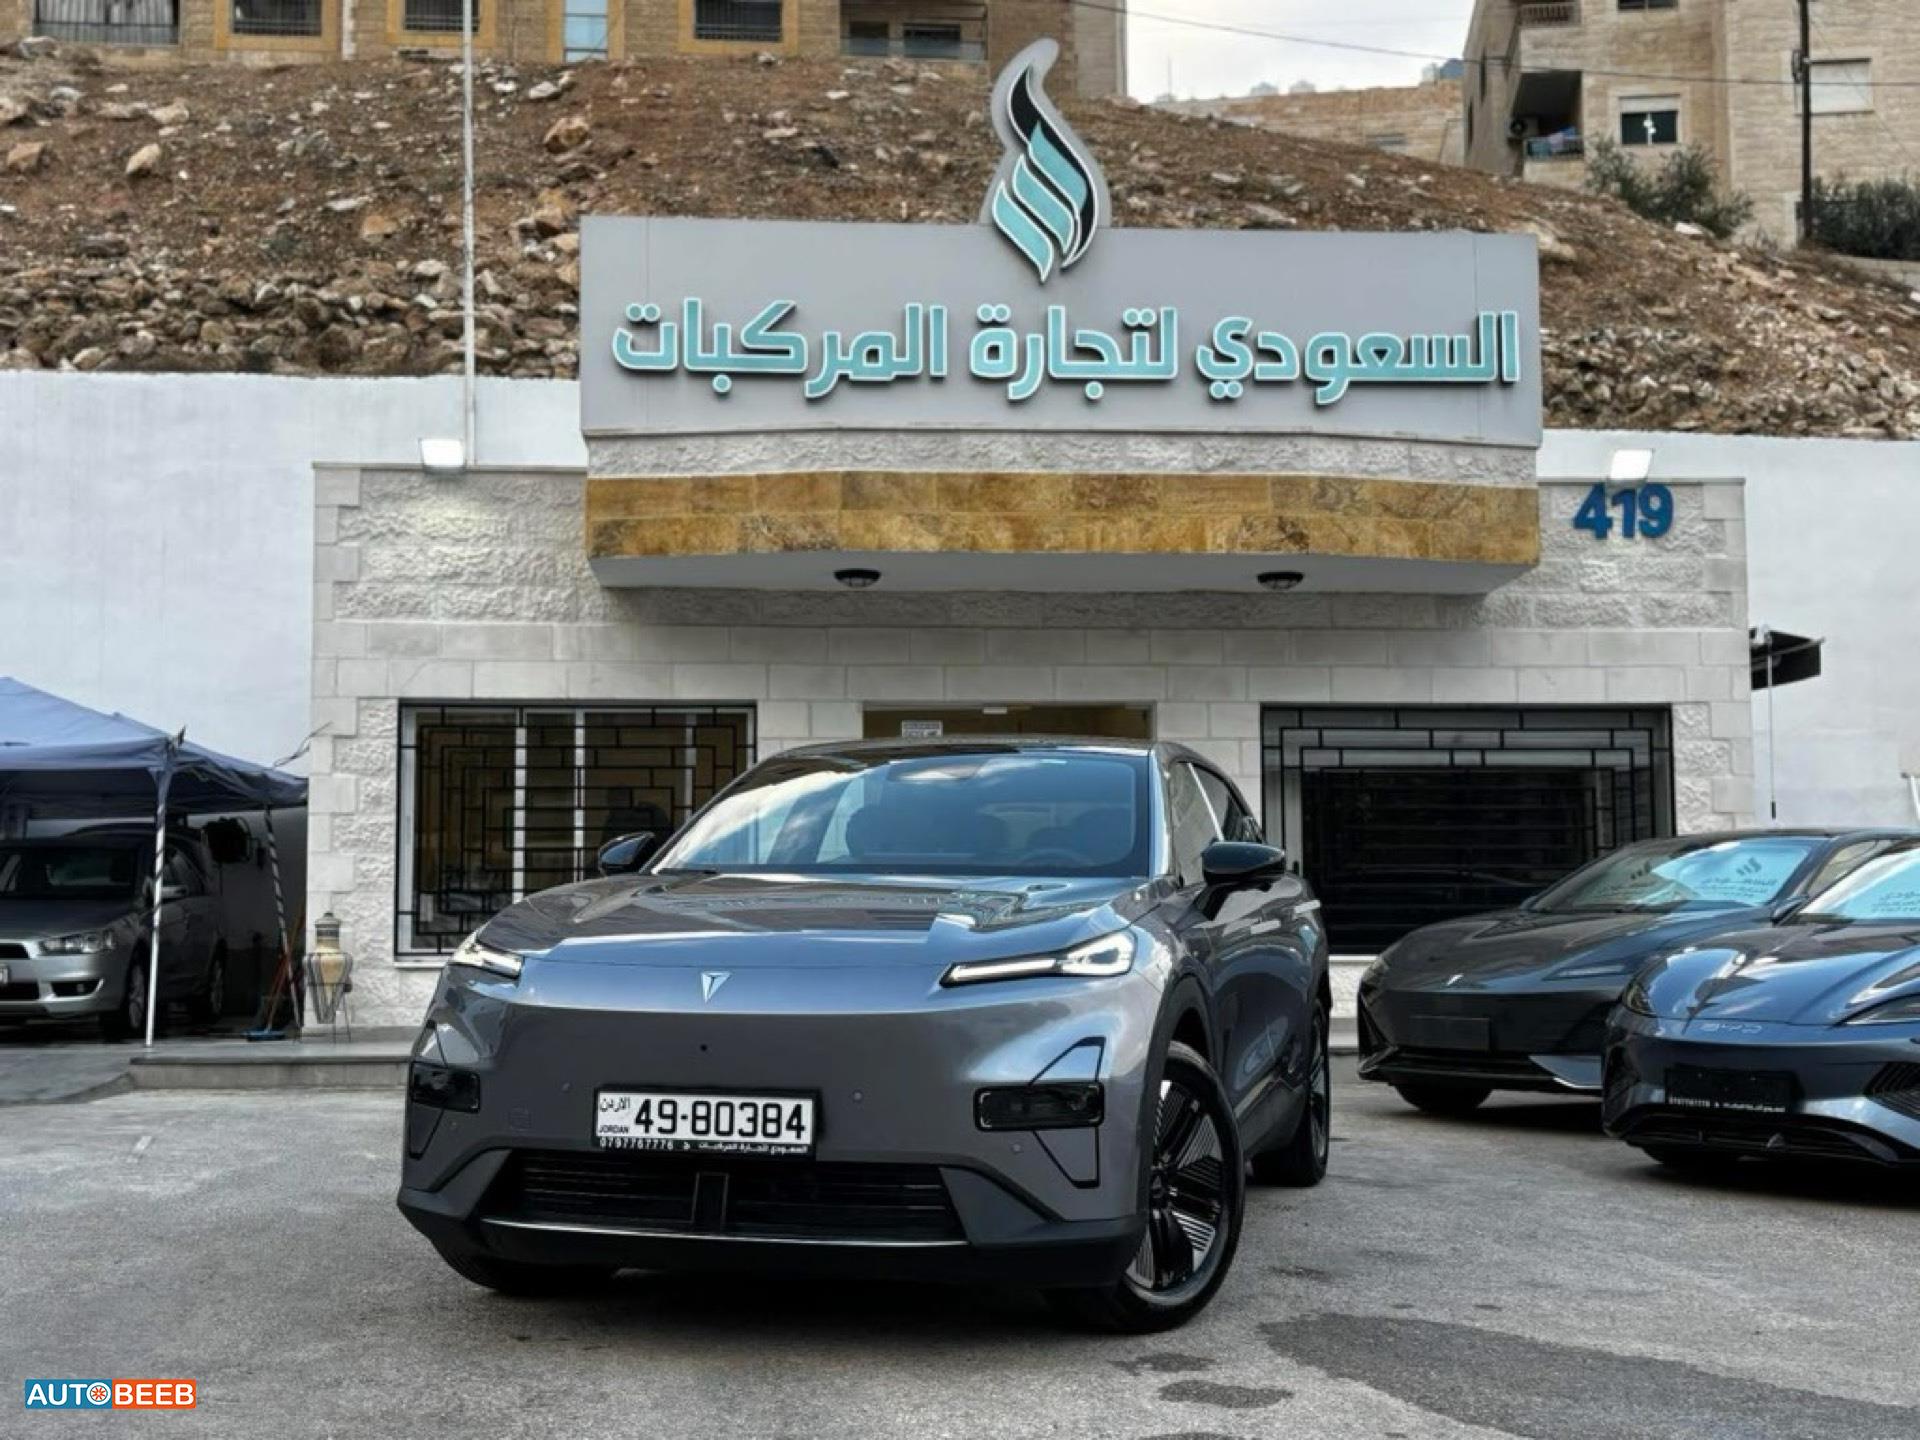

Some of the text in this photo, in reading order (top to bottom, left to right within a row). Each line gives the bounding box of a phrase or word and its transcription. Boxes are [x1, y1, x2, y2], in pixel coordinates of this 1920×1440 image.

[611, 297, 1520, 406] السعودي لتجارة المركبات
[1573, 483, 1673, 539] 419
[599, 1124, 629, 1135] JORDAN
[634, 1099, 806, 1140] 49-80384
